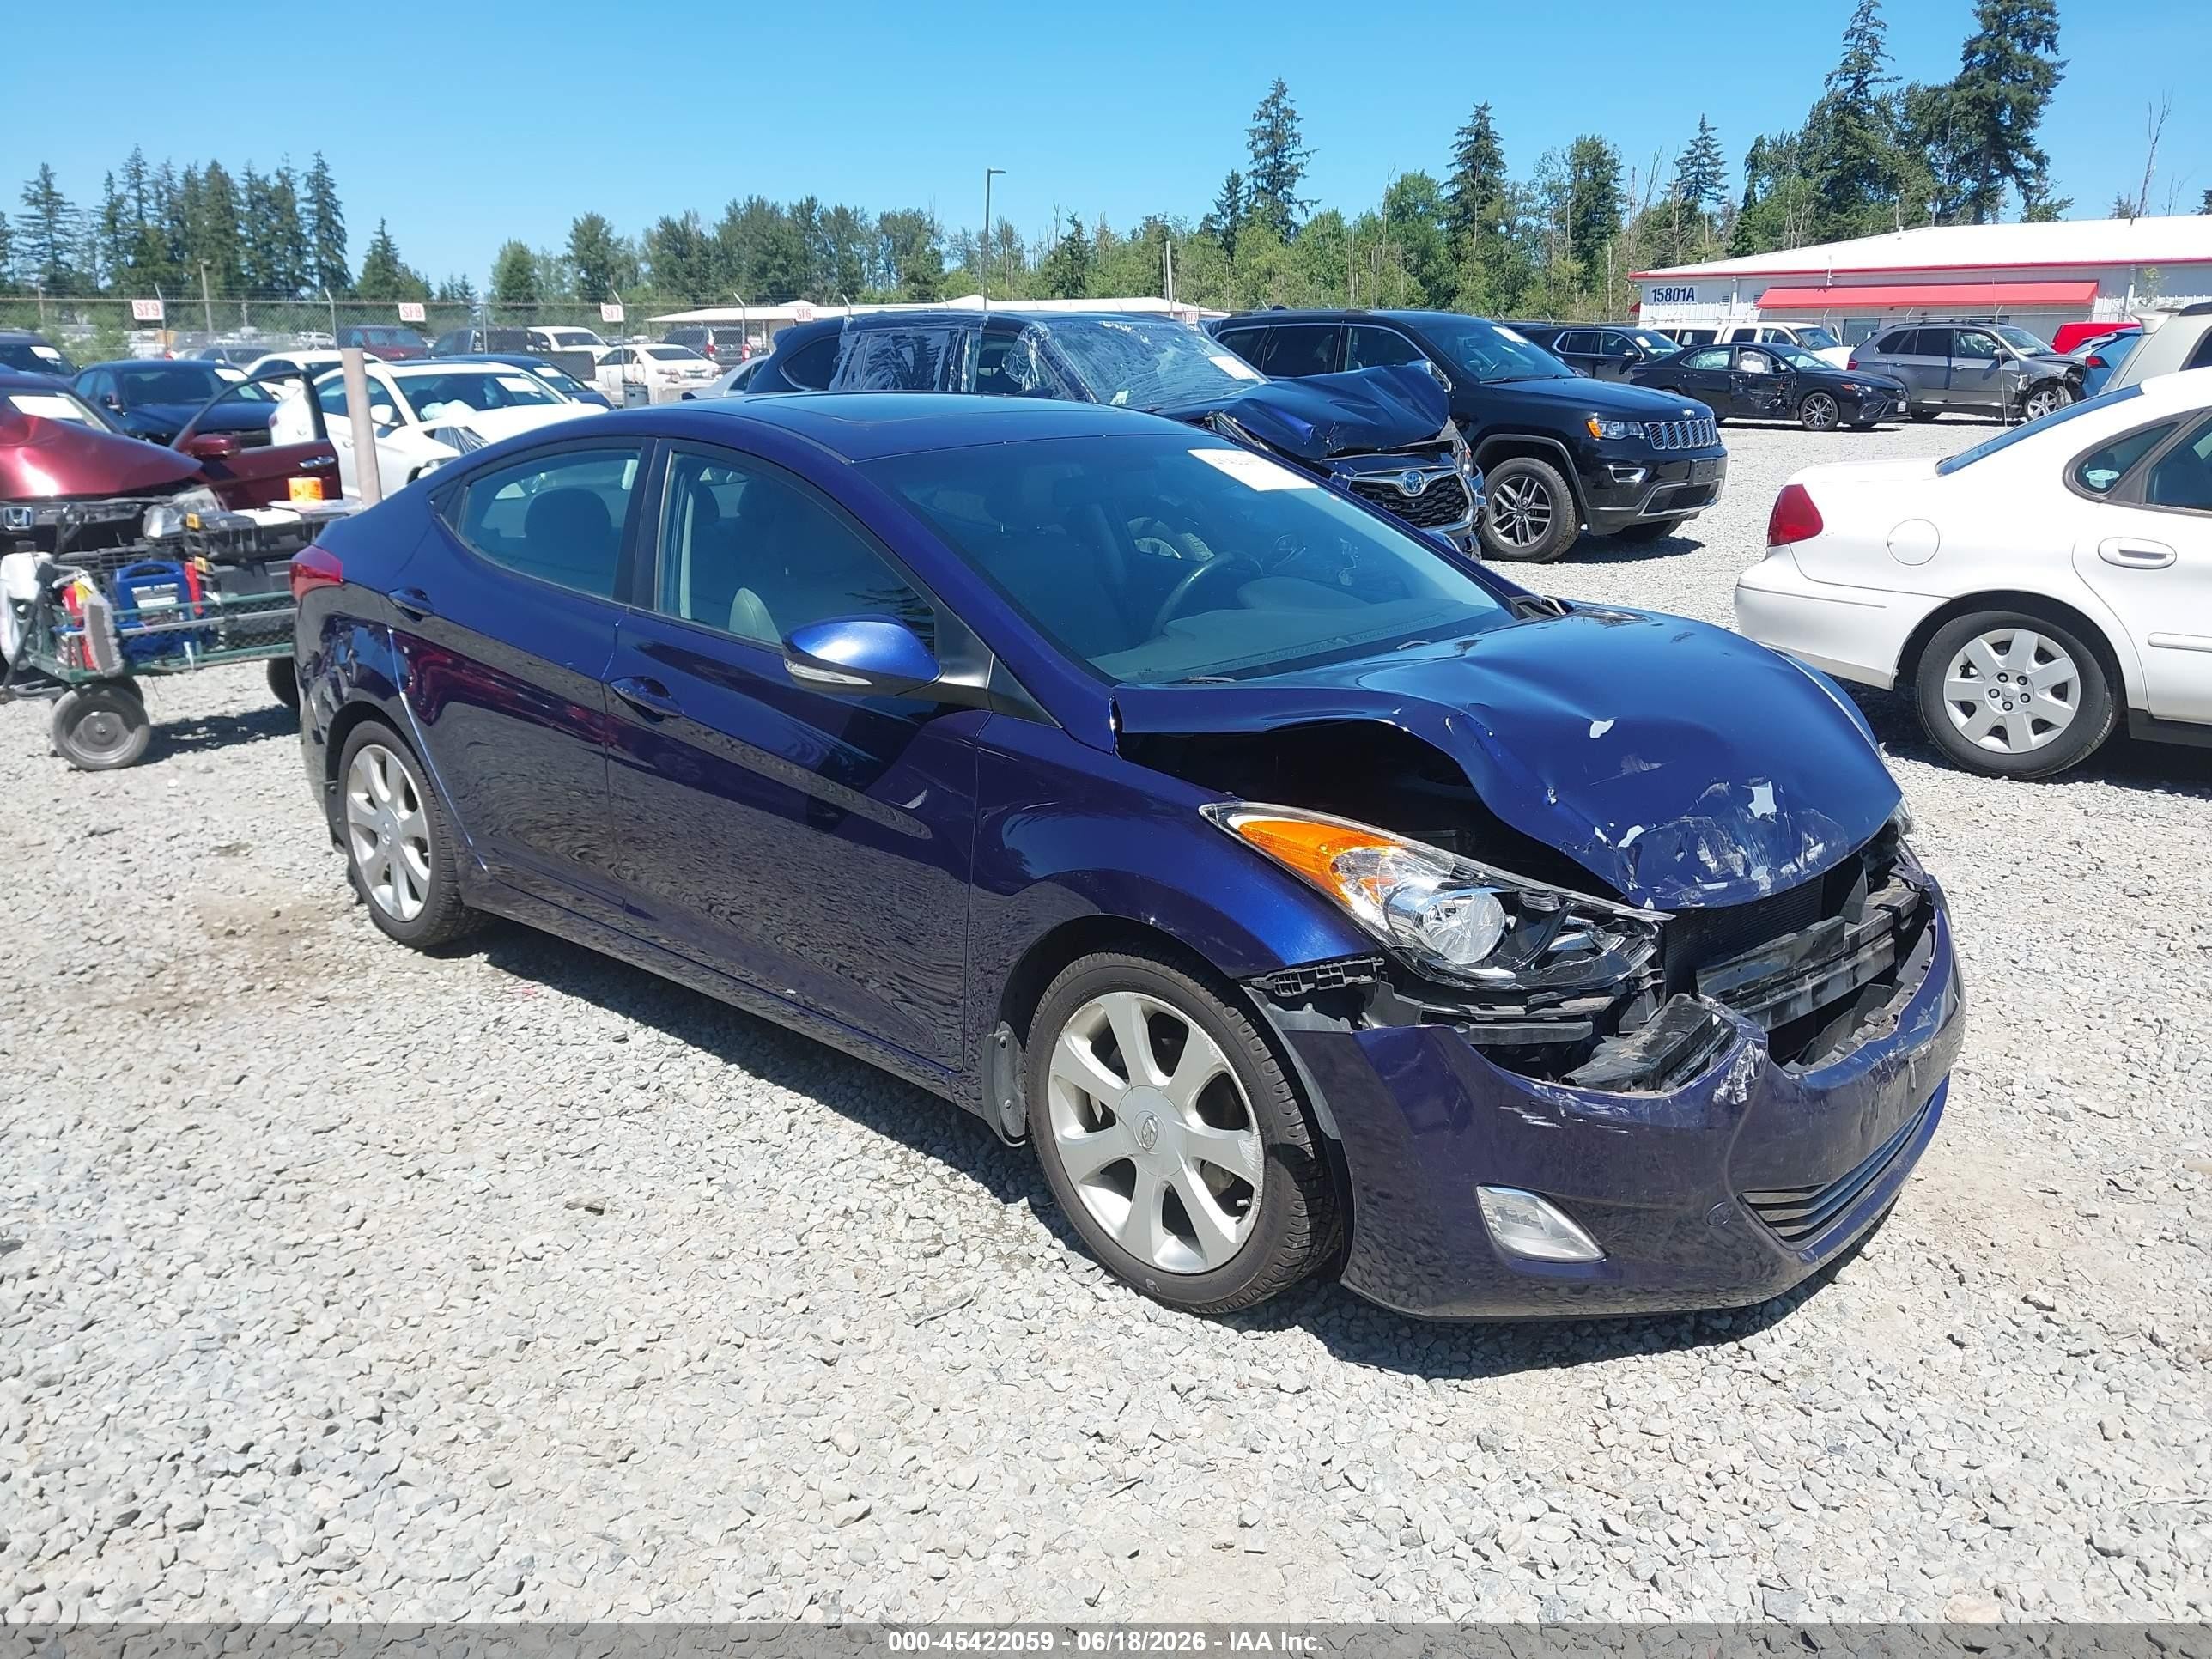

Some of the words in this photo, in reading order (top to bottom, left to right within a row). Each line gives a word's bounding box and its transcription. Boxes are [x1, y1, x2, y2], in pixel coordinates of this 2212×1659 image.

[1651, 287, 1695, 302] 15801A
[136, 301, 160, 317] SF9
[402, 305, 422, 318] SF8
[604, 307, 619, 319] SF7
[796, 308, 811, 319] SF6
